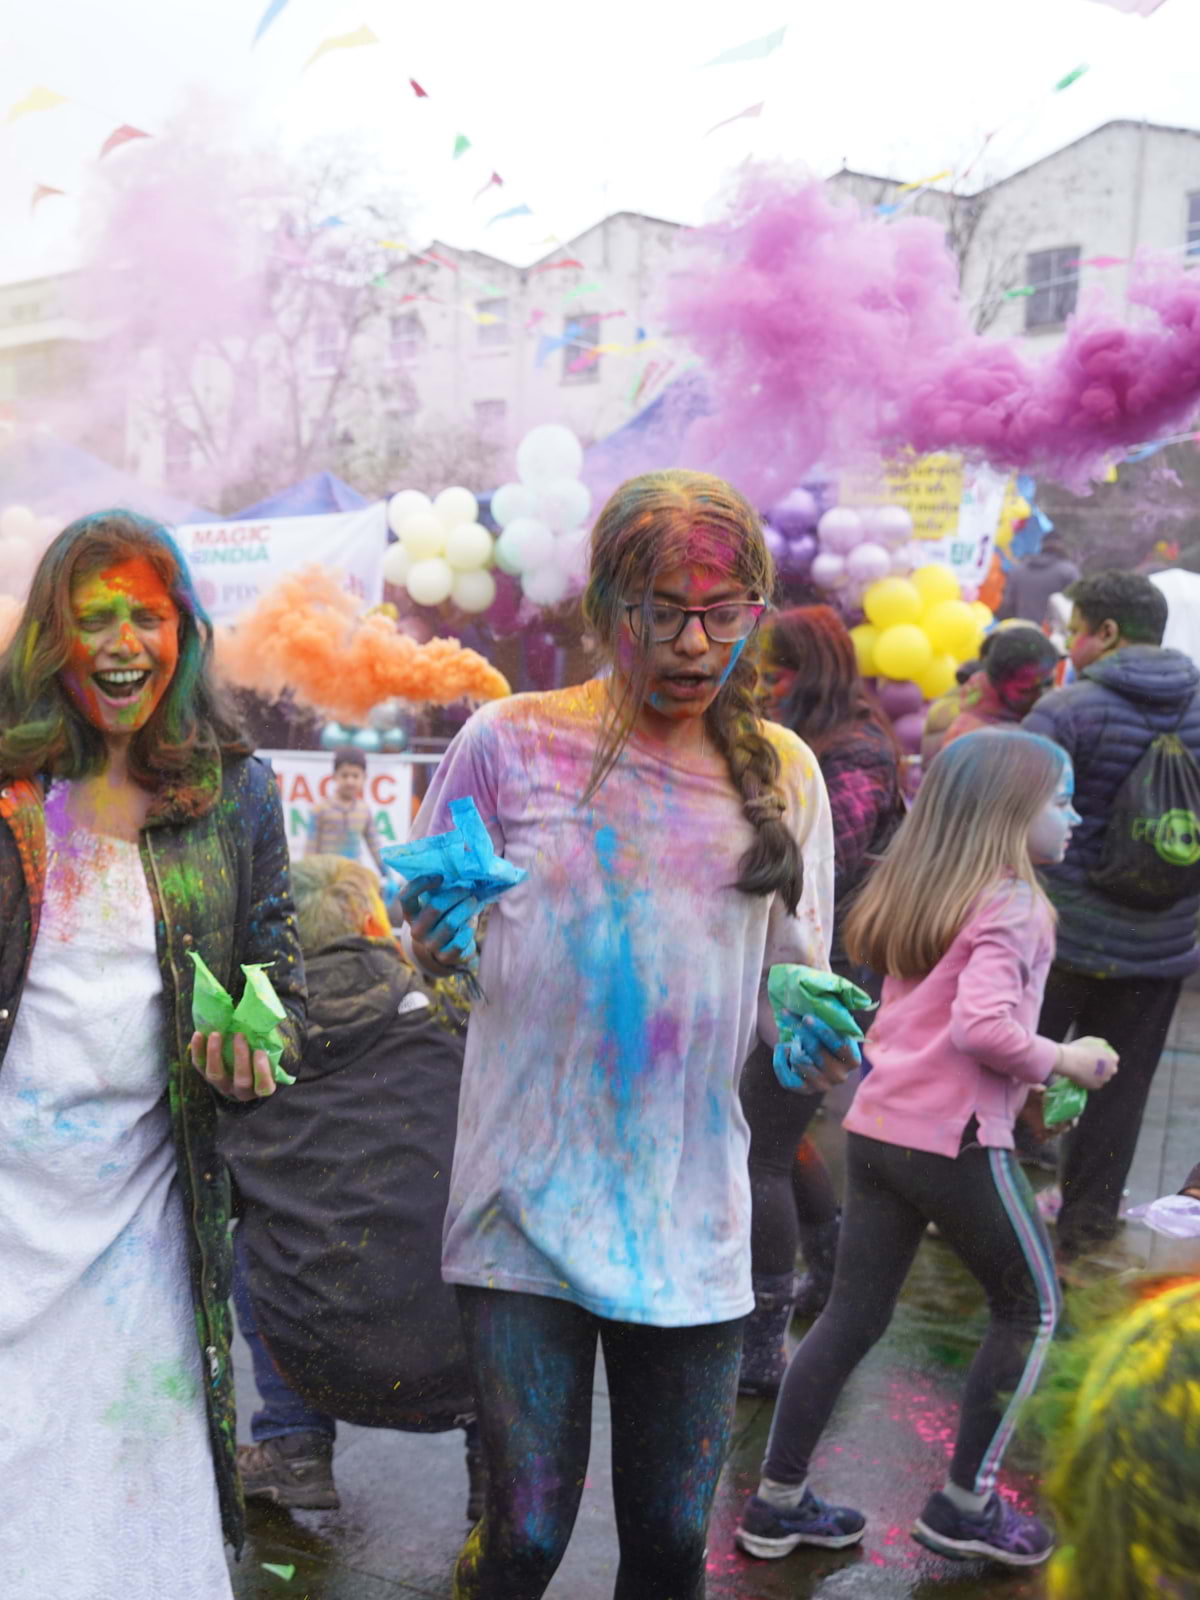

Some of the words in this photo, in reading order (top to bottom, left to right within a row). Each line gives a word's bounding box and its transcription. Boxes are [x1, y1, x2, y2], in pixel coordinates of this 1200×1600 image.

[192, 525, 271, 545] MAGIC
[203, 545, 269, 565] INDIA
[275, 771, 397, 805] AGC
